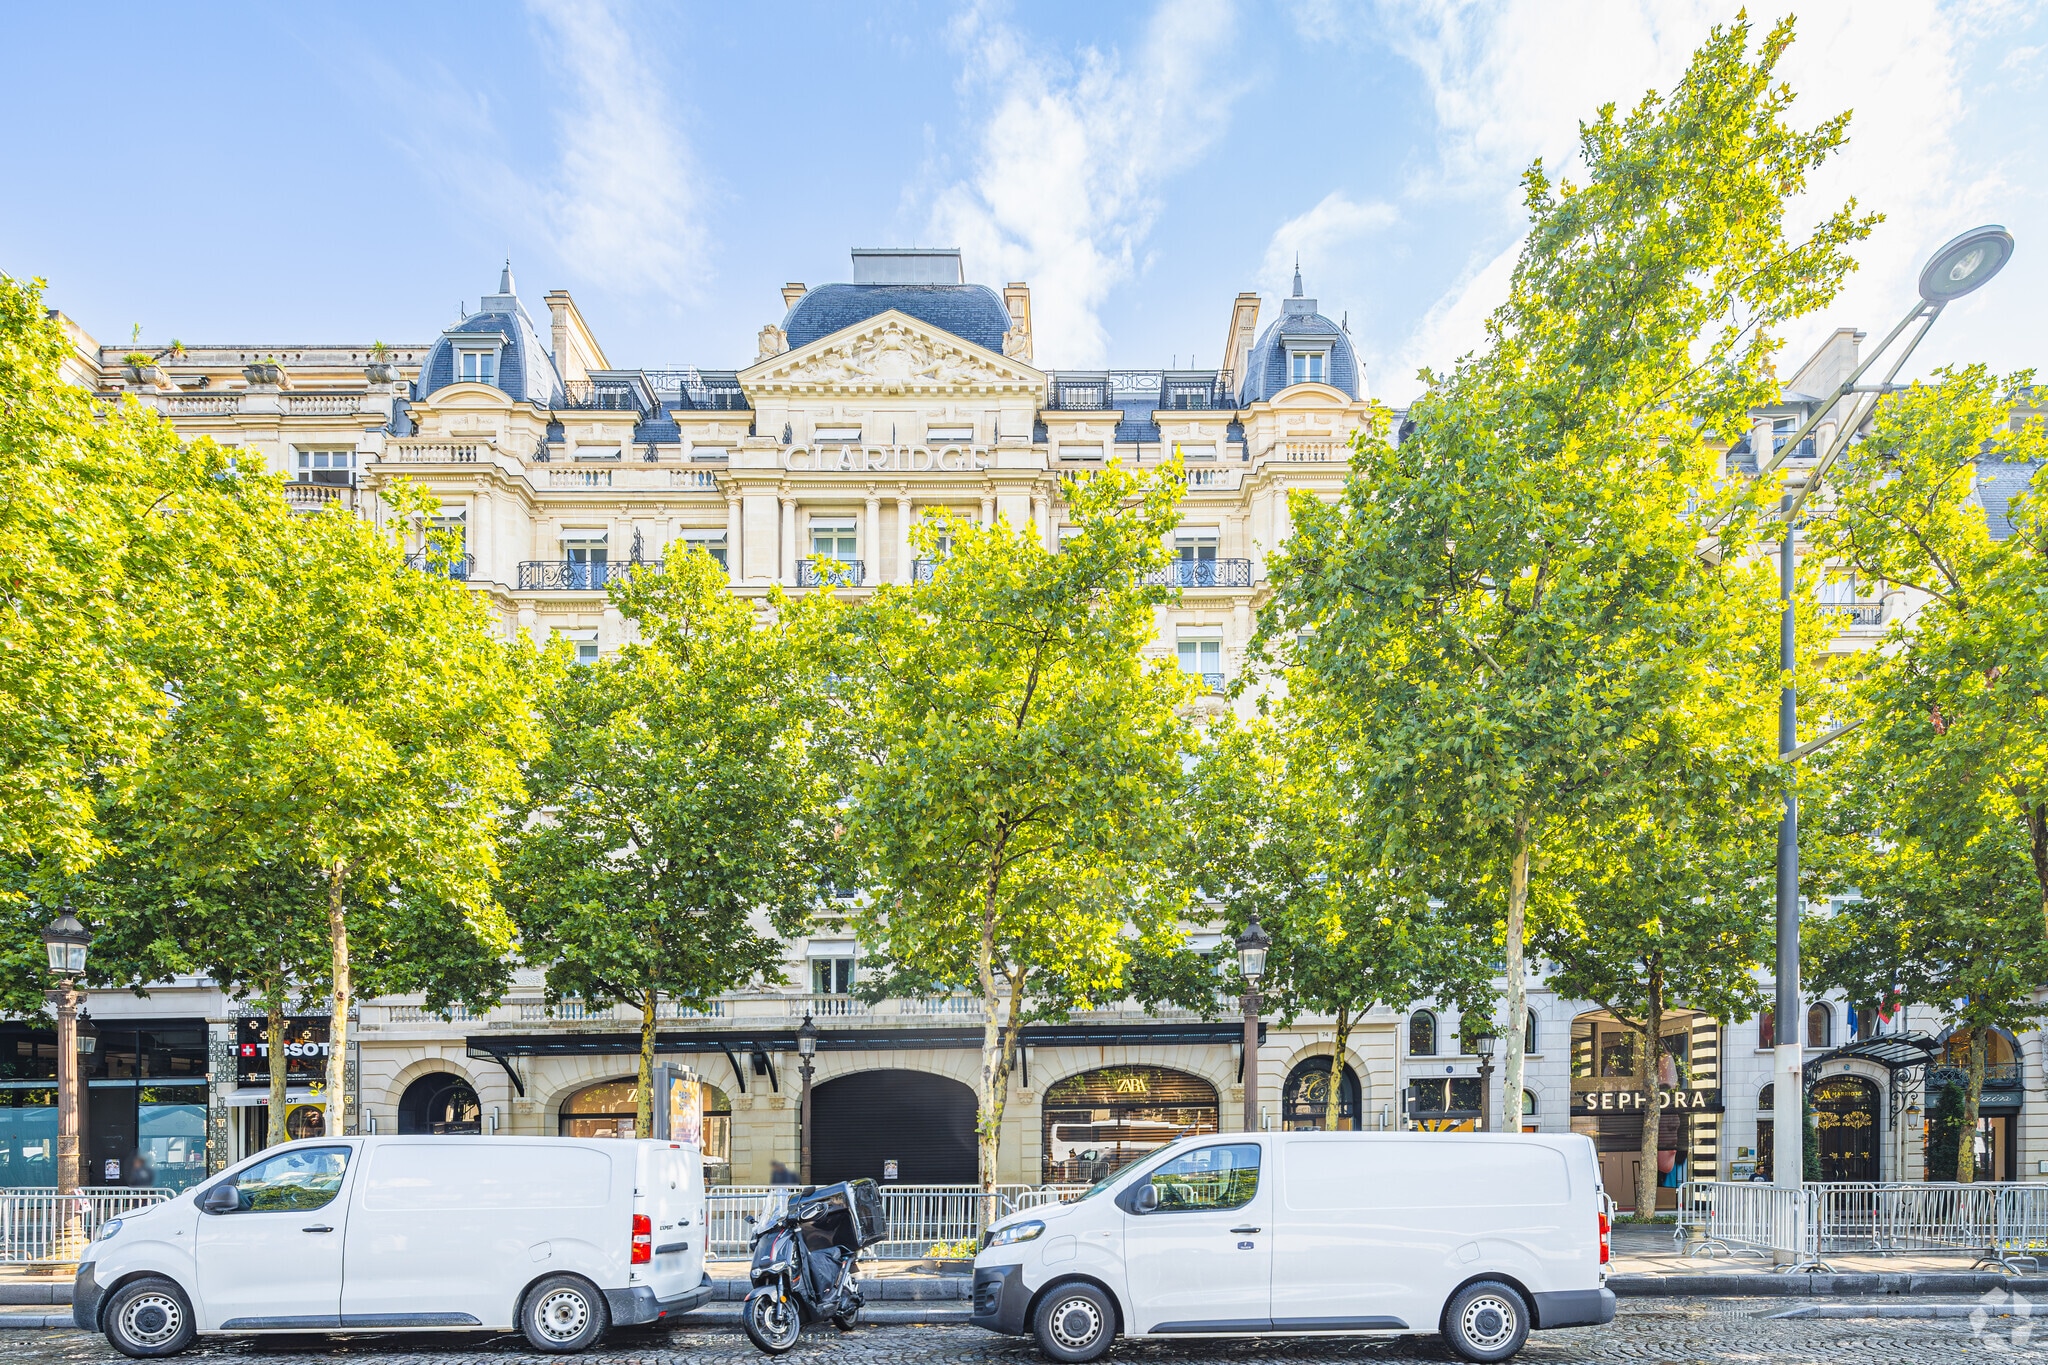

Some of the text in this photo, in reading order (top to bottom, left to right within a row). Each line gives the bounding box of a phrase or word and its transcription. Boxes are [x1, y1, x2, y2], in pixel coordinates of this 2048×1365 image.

[783, 444, 989, 471] CLARIDGE
[256, 1042, 330, 1057] TSOT
[1116, 1078, 1148, 1093] ZARA
[1586, 1091, 1706, 1110] SEPHORA
